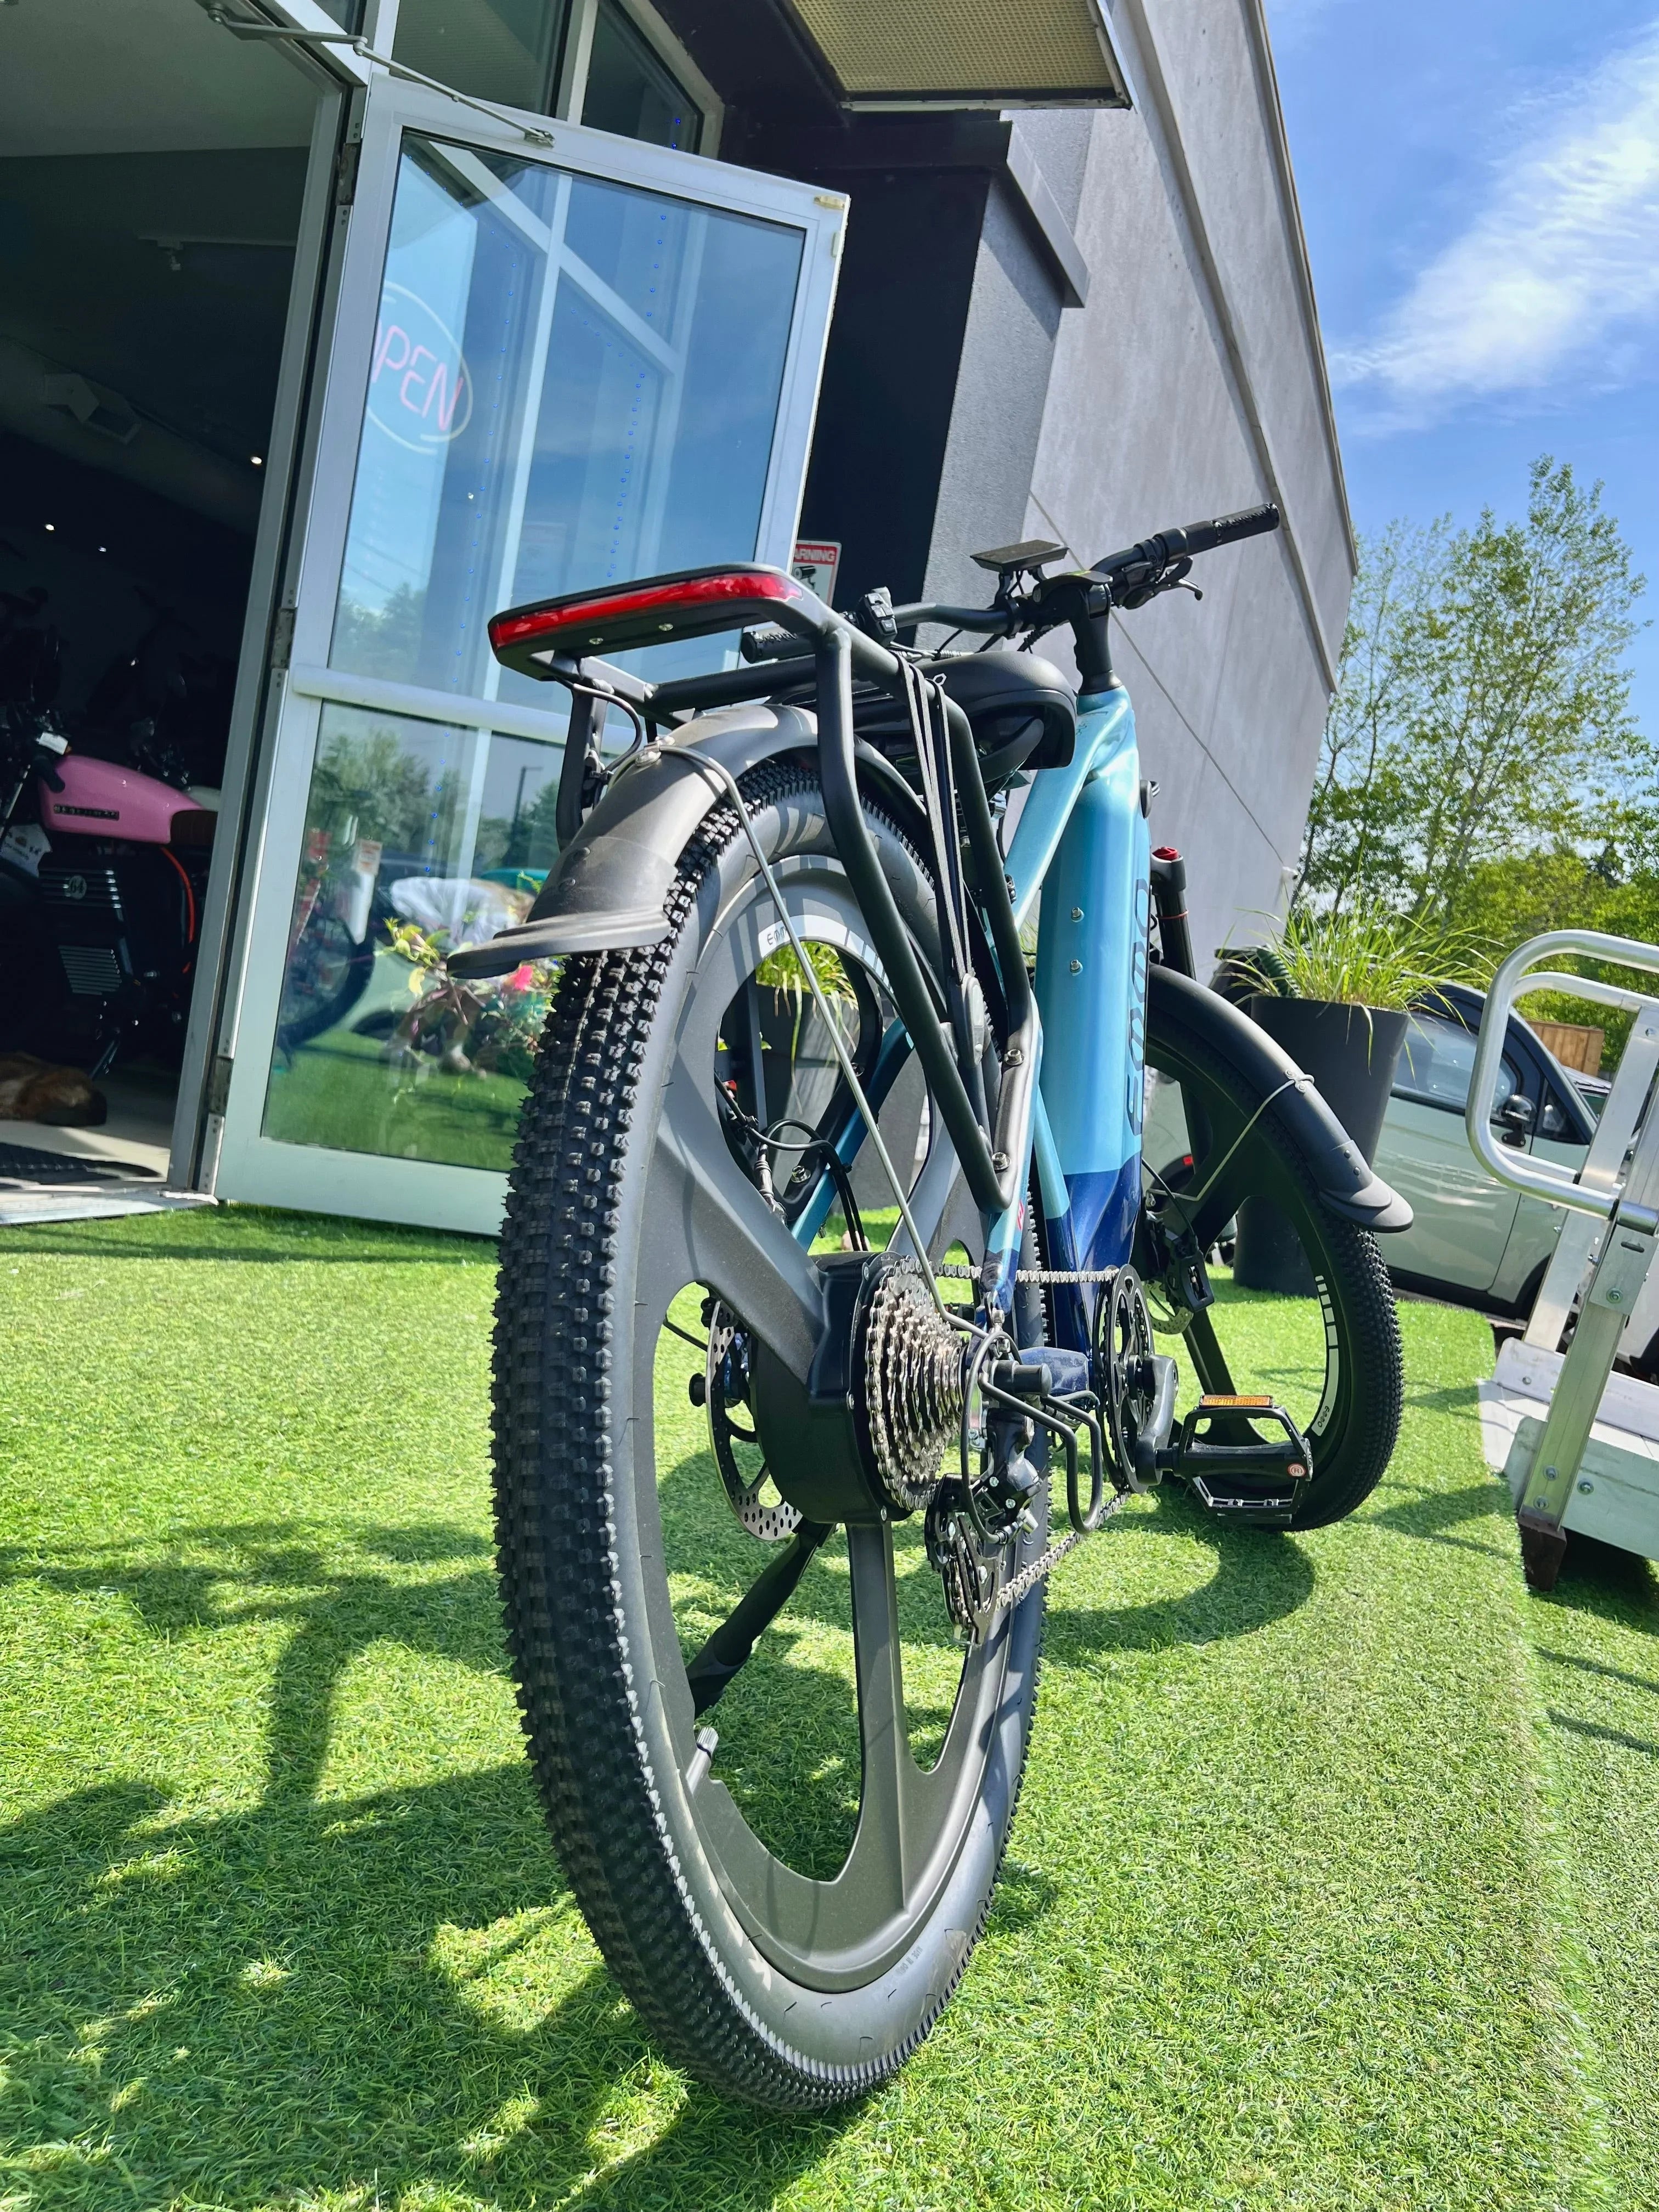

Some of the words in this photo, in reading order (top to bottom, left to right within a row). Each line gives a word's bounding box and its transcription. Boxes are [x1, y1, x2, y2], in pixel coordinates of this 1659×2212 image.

[371, 320, 465, 431] PEN
[794, 548, 836, 562] ARNING
[768, 926, 788, 945] EMM
